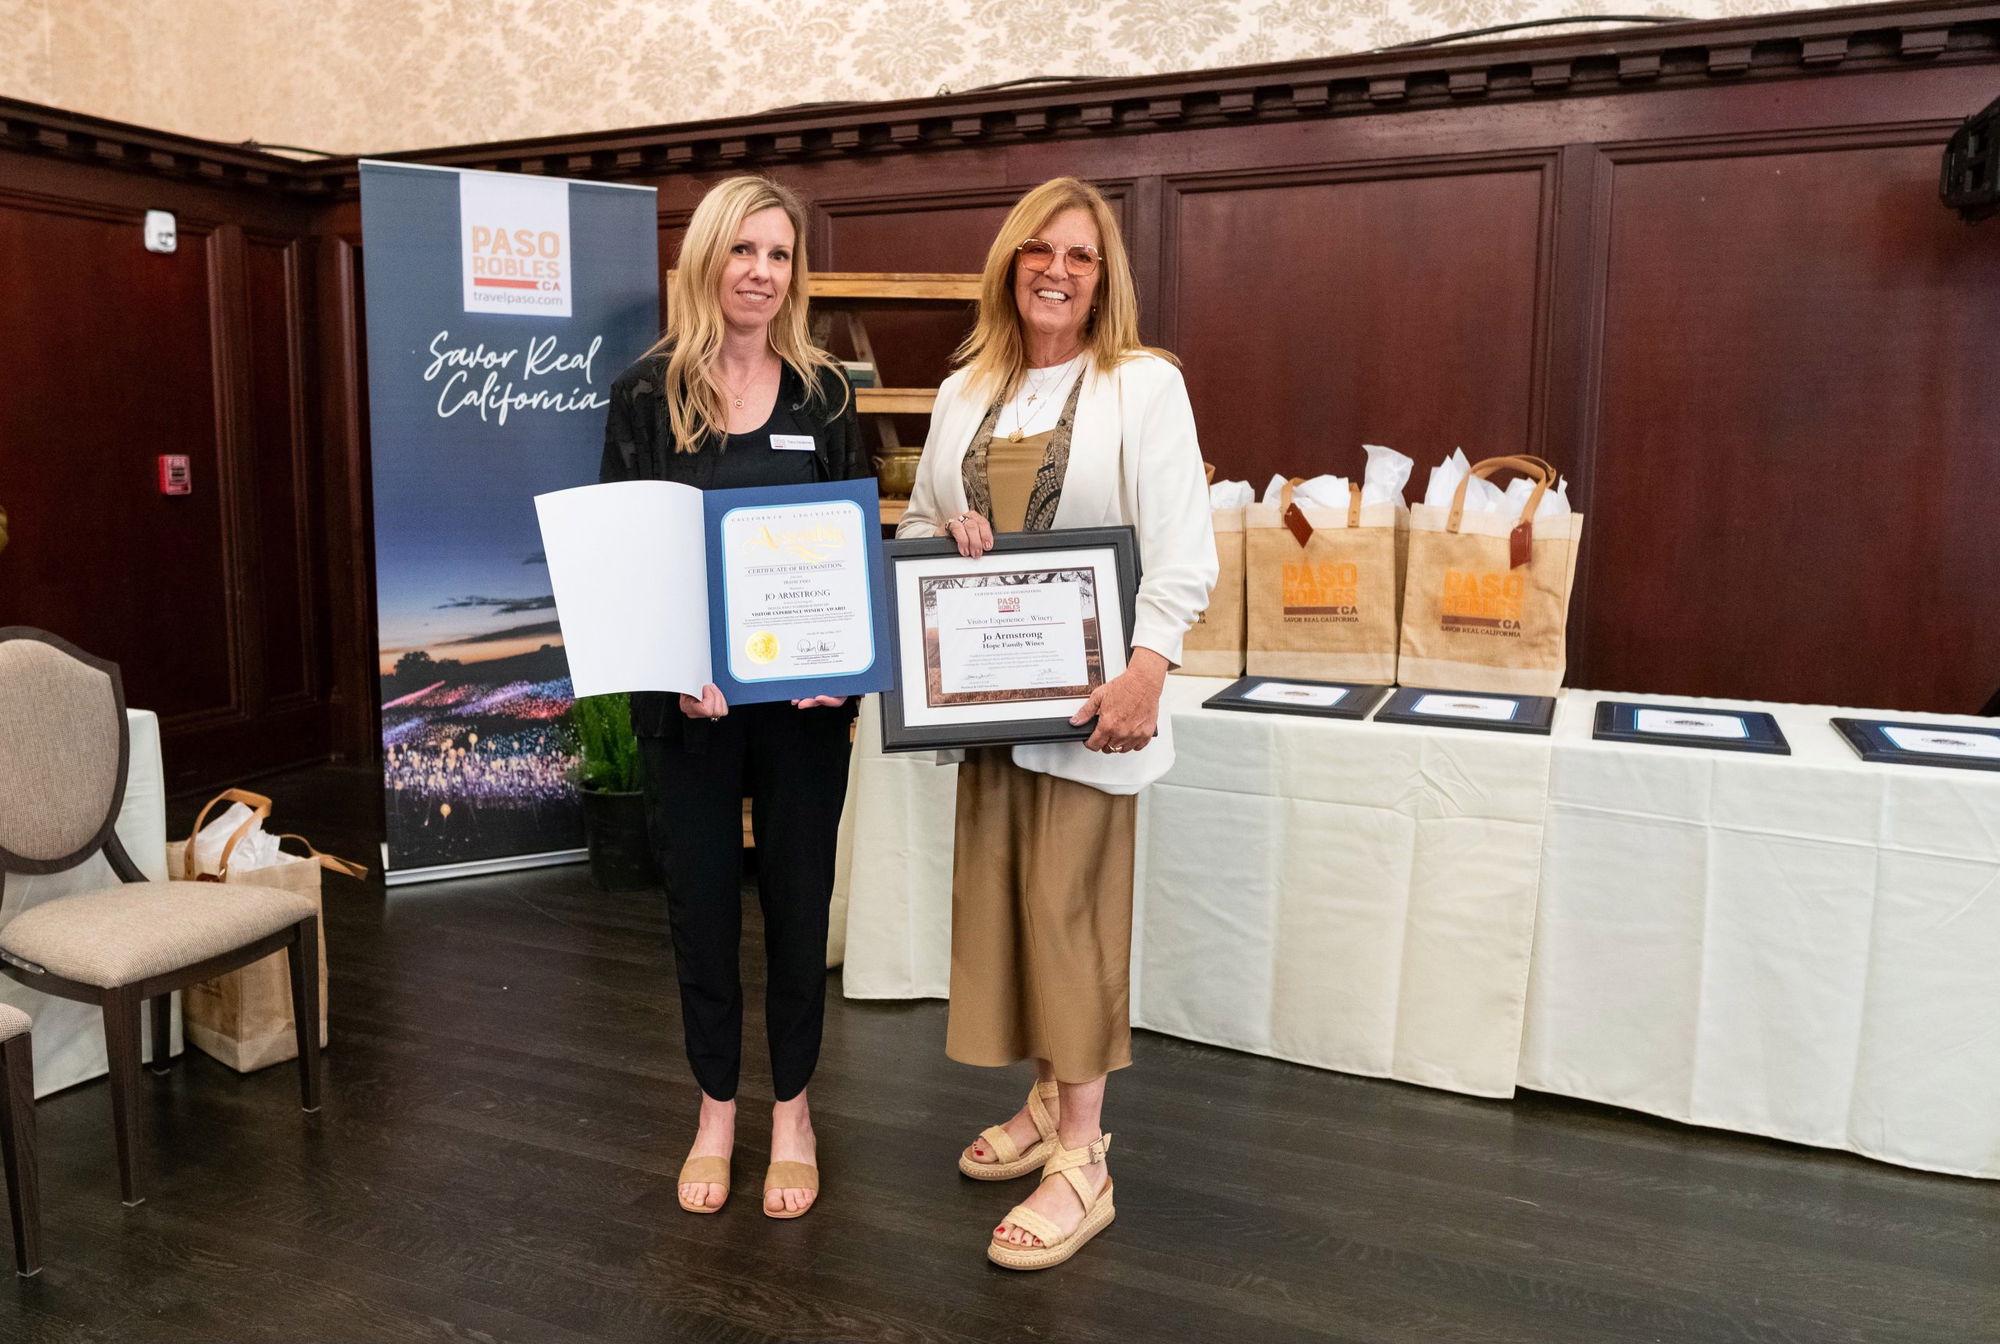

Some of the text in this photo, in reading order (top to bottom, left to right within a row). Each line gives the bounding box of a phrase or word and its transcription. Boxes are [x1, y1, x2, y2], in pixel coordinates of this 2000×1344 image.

[472, 225, 560, 259] PASO
[472, 256, 561, 280] ROBLES
[542, 281, 561, 292] CA
[473, 291, 563, 305] travelpaso.com
[424, 330, 603, 385] Savor Real
[437, 370, 611, 426] California
[748, 566, 787, 575] CERTIFICATE
[799, 562, 843, 572] RECOGNITION
[1283, 562, 1358, 588] PASO
[1444, 571, 1524, 599] PASO
[765, 589, 831, 601] JO ARMSTRONG
[997, 597, 1020, 605] PASO
[1341, 605, 1358, 615] CA
[990, 617, 1025, 625] Experience
[1503, 619, 1521, 630] CA
[982, 631, 1043, 642] Jo Armstrong
[1441, 625, 1461, 633] SAVOR
[1480, 628, 1521, 638] CALIFORNIA
